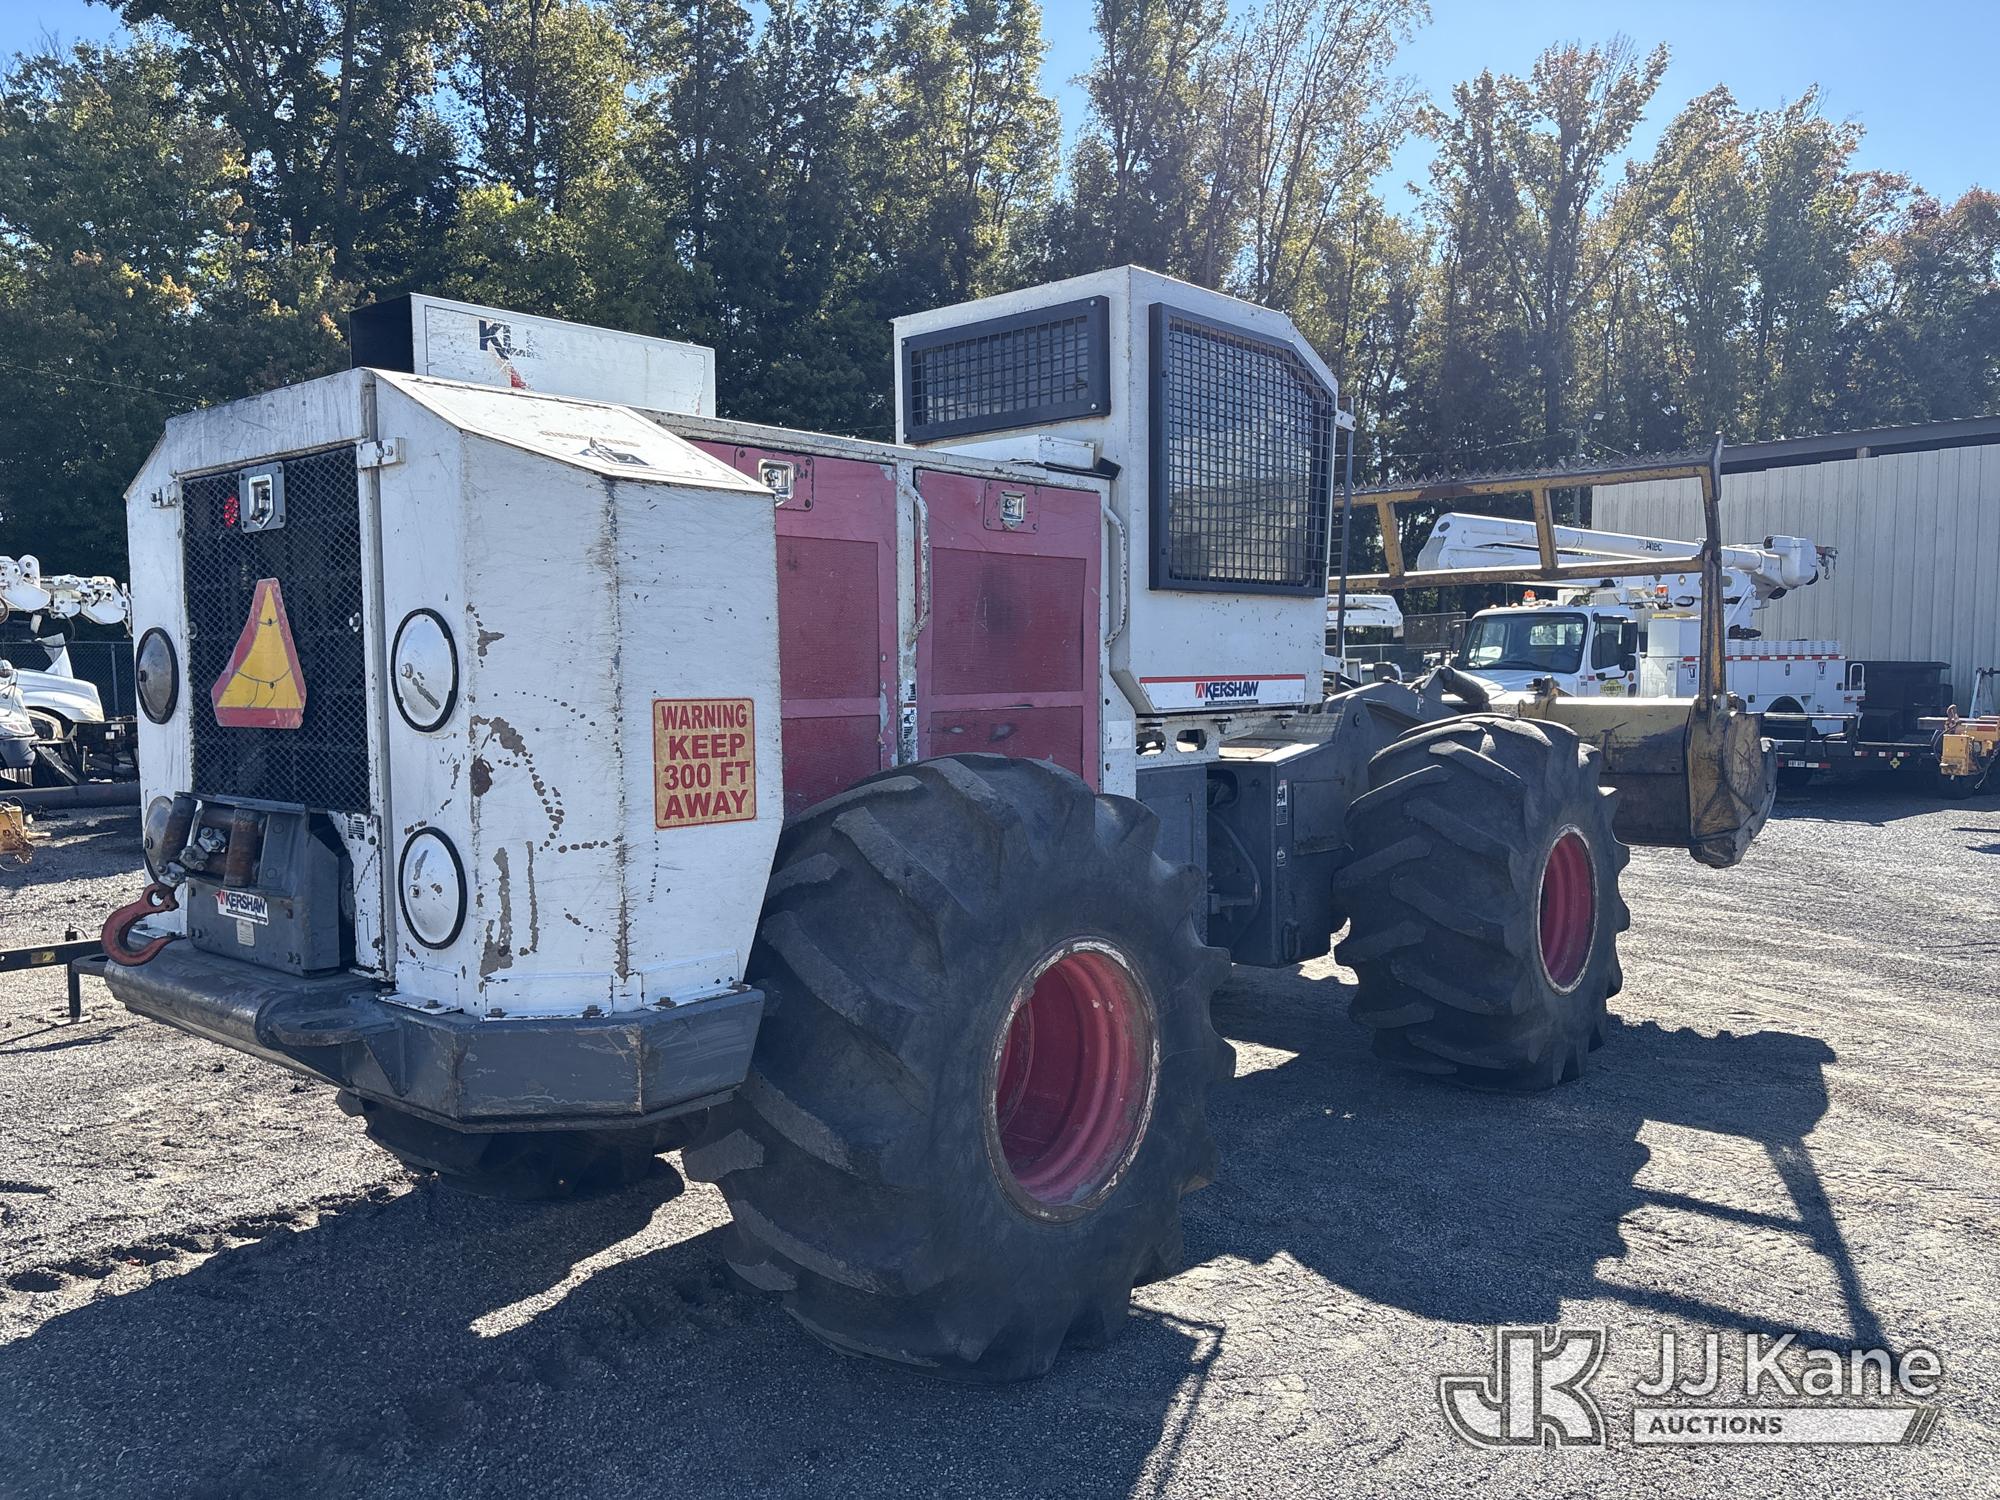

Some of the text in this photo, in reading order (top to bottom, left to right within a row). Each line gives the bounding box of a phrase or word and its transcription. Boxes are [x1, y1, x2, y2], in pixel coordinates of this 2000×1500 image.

[1205, 681, 1260, 700] KERSHAW
[661, 703, 748, 731] WARNING
[669, 733, 746, 760] KEEP
[663, 760, 751, 790] 300 FT
[663, 789, 749, 820] AWAY
[225, 892, 266, 914] KERSHAW
